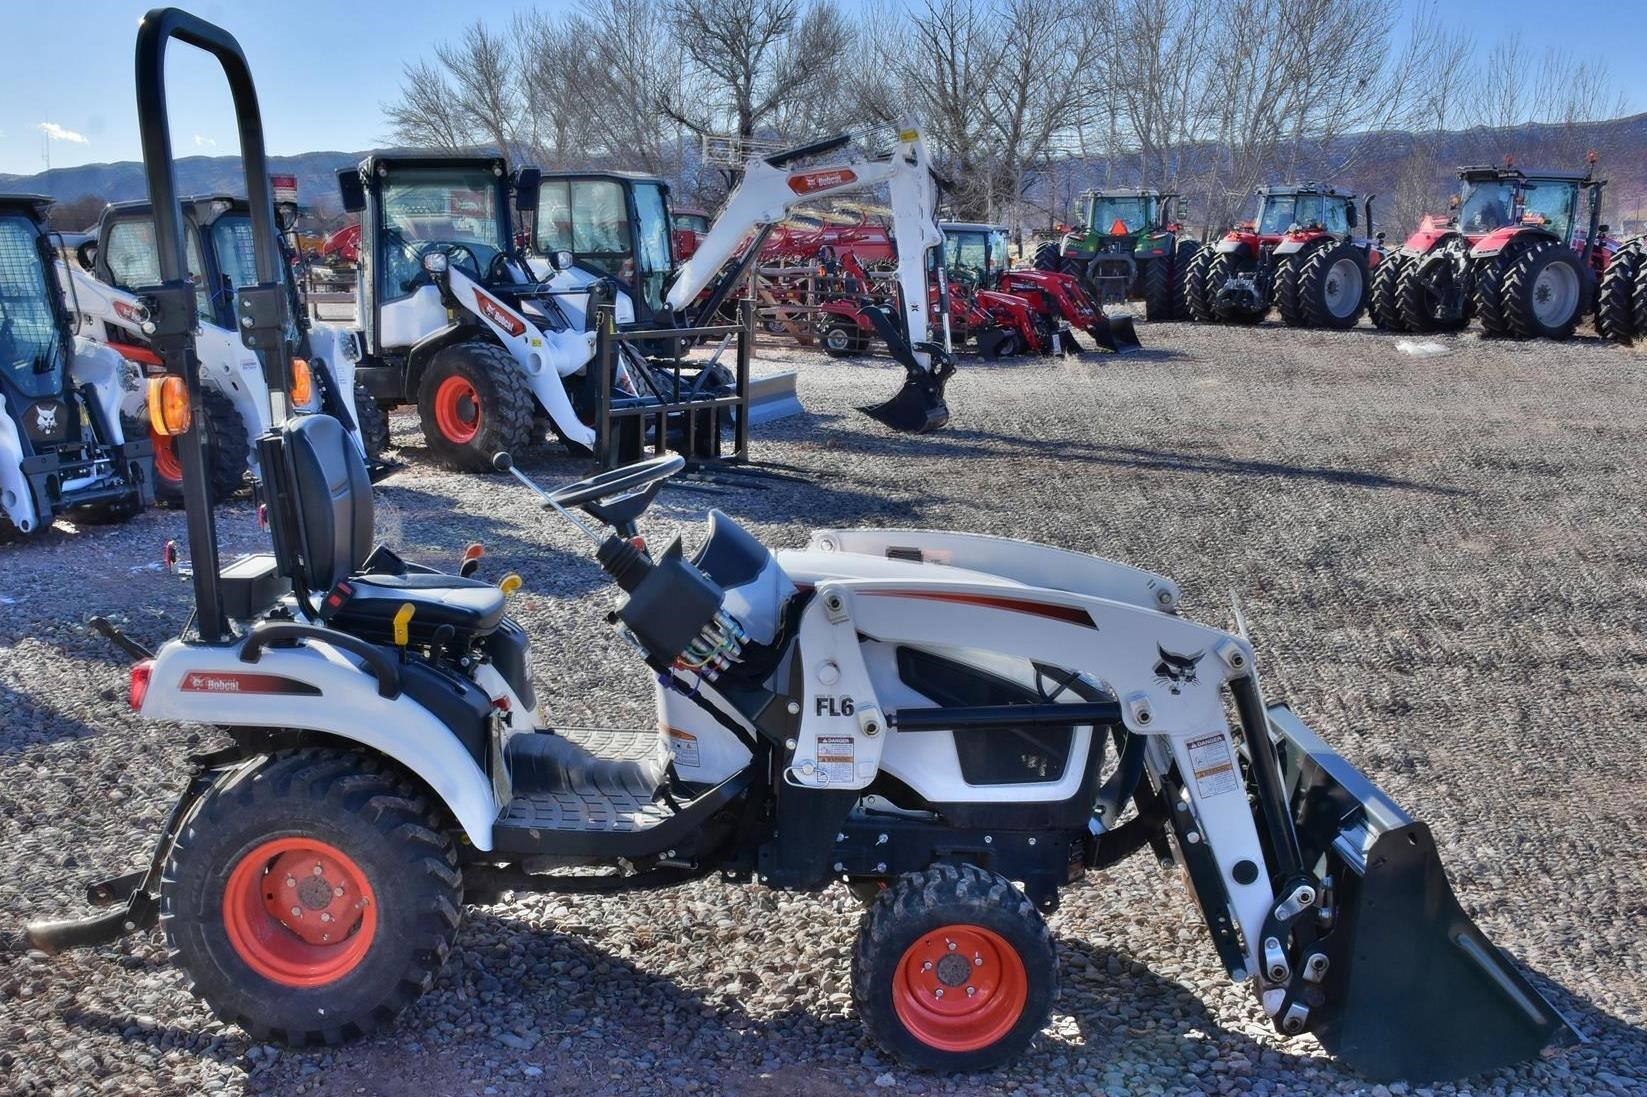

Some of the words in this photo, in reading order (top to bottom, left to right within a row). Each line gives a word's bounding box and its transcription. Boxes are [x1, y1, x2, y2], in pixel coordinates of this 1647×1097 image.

[494, 311, 514, 332] Bobcat
[207, 678, 239, 691] Bobcat
[816, 697, 855, 717] FL6
[1197, 736, 1223, 747] DANGER
